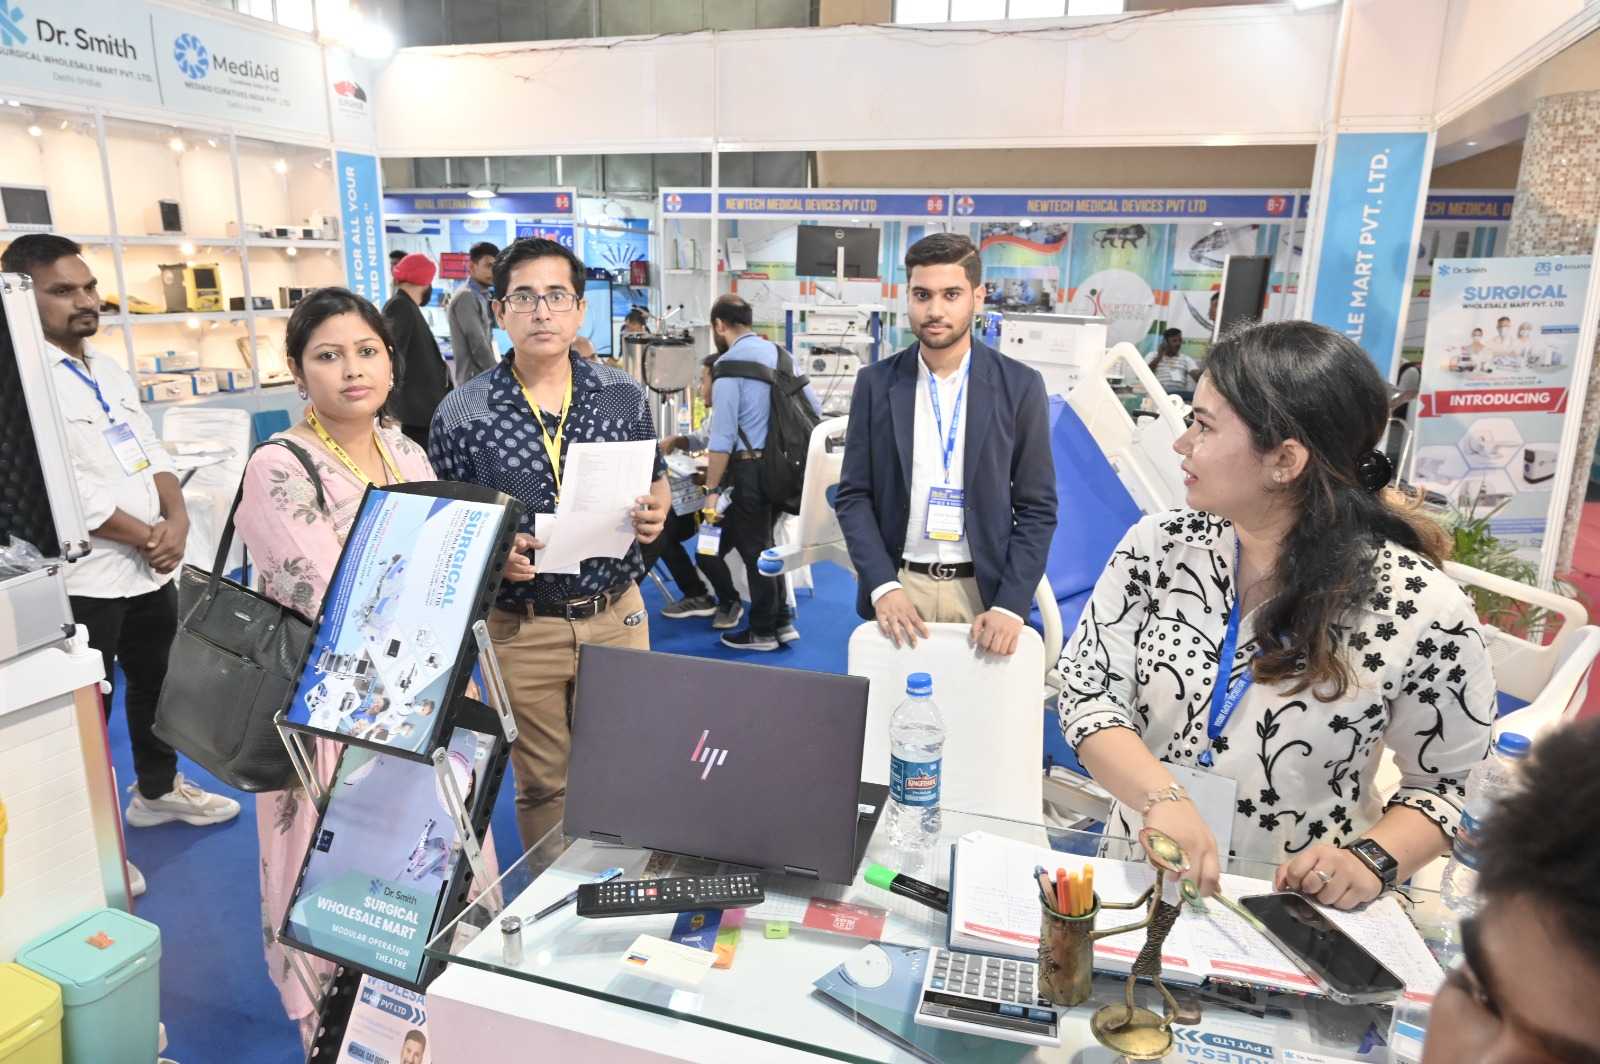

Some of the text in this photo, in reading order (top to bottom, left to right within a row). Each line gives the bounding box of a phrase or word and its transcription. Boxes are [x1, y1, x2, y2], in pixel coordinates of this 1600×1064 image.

[36, 18, 137, 60] Dr. Smith
[44, 55, 95, 73] WHOLESALE
[96, 65, 118, 77] MART
[212, 53, 280, 83] MediAid
[1366, 147, 1392, 194] LTD.
[344, 166, 358, 212] YOUR
[725, 198, 877, 212] NEWTECH MEDICAL DEVICES PVT LTD
[1027, 199, 1207, 212] NEWTECH MEDICAL DEVICES PVT LTD
[1266, 199, 1287, 212] B-7
[349, 212, 361, 244] ALL
[1358, 199, 1383, 246] PVT.
[350, 247, 364, 281] FOR
[1350, 250, 1374, 308] MART
[1463, 284, 1568, 301] SURGICAL
[1462, 302, 1507, 310] WHOLESALE
[1449, 392, 1551, 406] INTRODUCING
[443, 509, 482, 607] SURGICAL
[384, 887, 417, 905] Dr. Smith
[317, 896, 417, 940] WHOLESALE MART
[363, 896, 419, 925] SURGICAL
[331, 924, 410, 957] MODULAR OPERATION
[375, 952, 408, 970] THEATRE
[380, 999, 393, 1010] PVT
[393, 1006, 407, 1016] LTD
[1212, 1037, 1236, 1047] LTD
[1238, 1041, 1262, 1055] PVT
